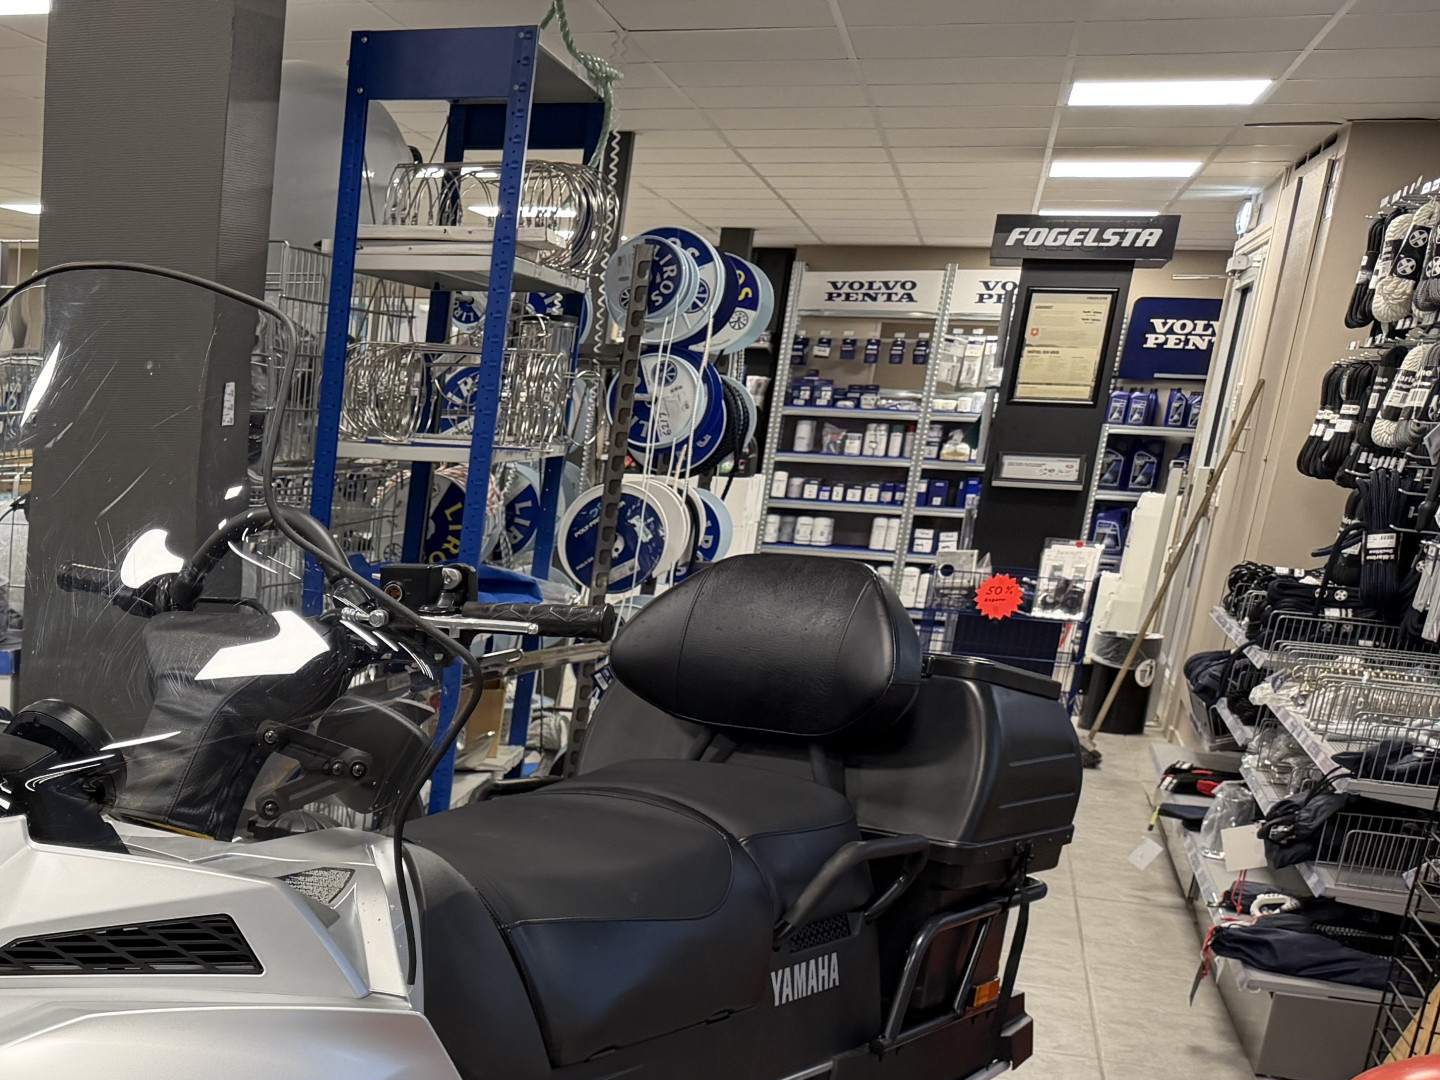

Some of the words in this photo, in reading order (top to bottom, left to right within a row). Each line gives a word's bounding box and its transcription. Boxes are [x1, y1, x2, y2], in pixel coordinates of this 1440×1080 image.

[1004, 227, 1164, 248] FOGELSTA
[826, 279, 918, 292] VOLVO
[824, 291, 918, 303] PENTA
[985, 585, 1003, 596] 50
[1004, 584, 1015, 595] %
[770, 951, 840, 1007] YAMAHA
